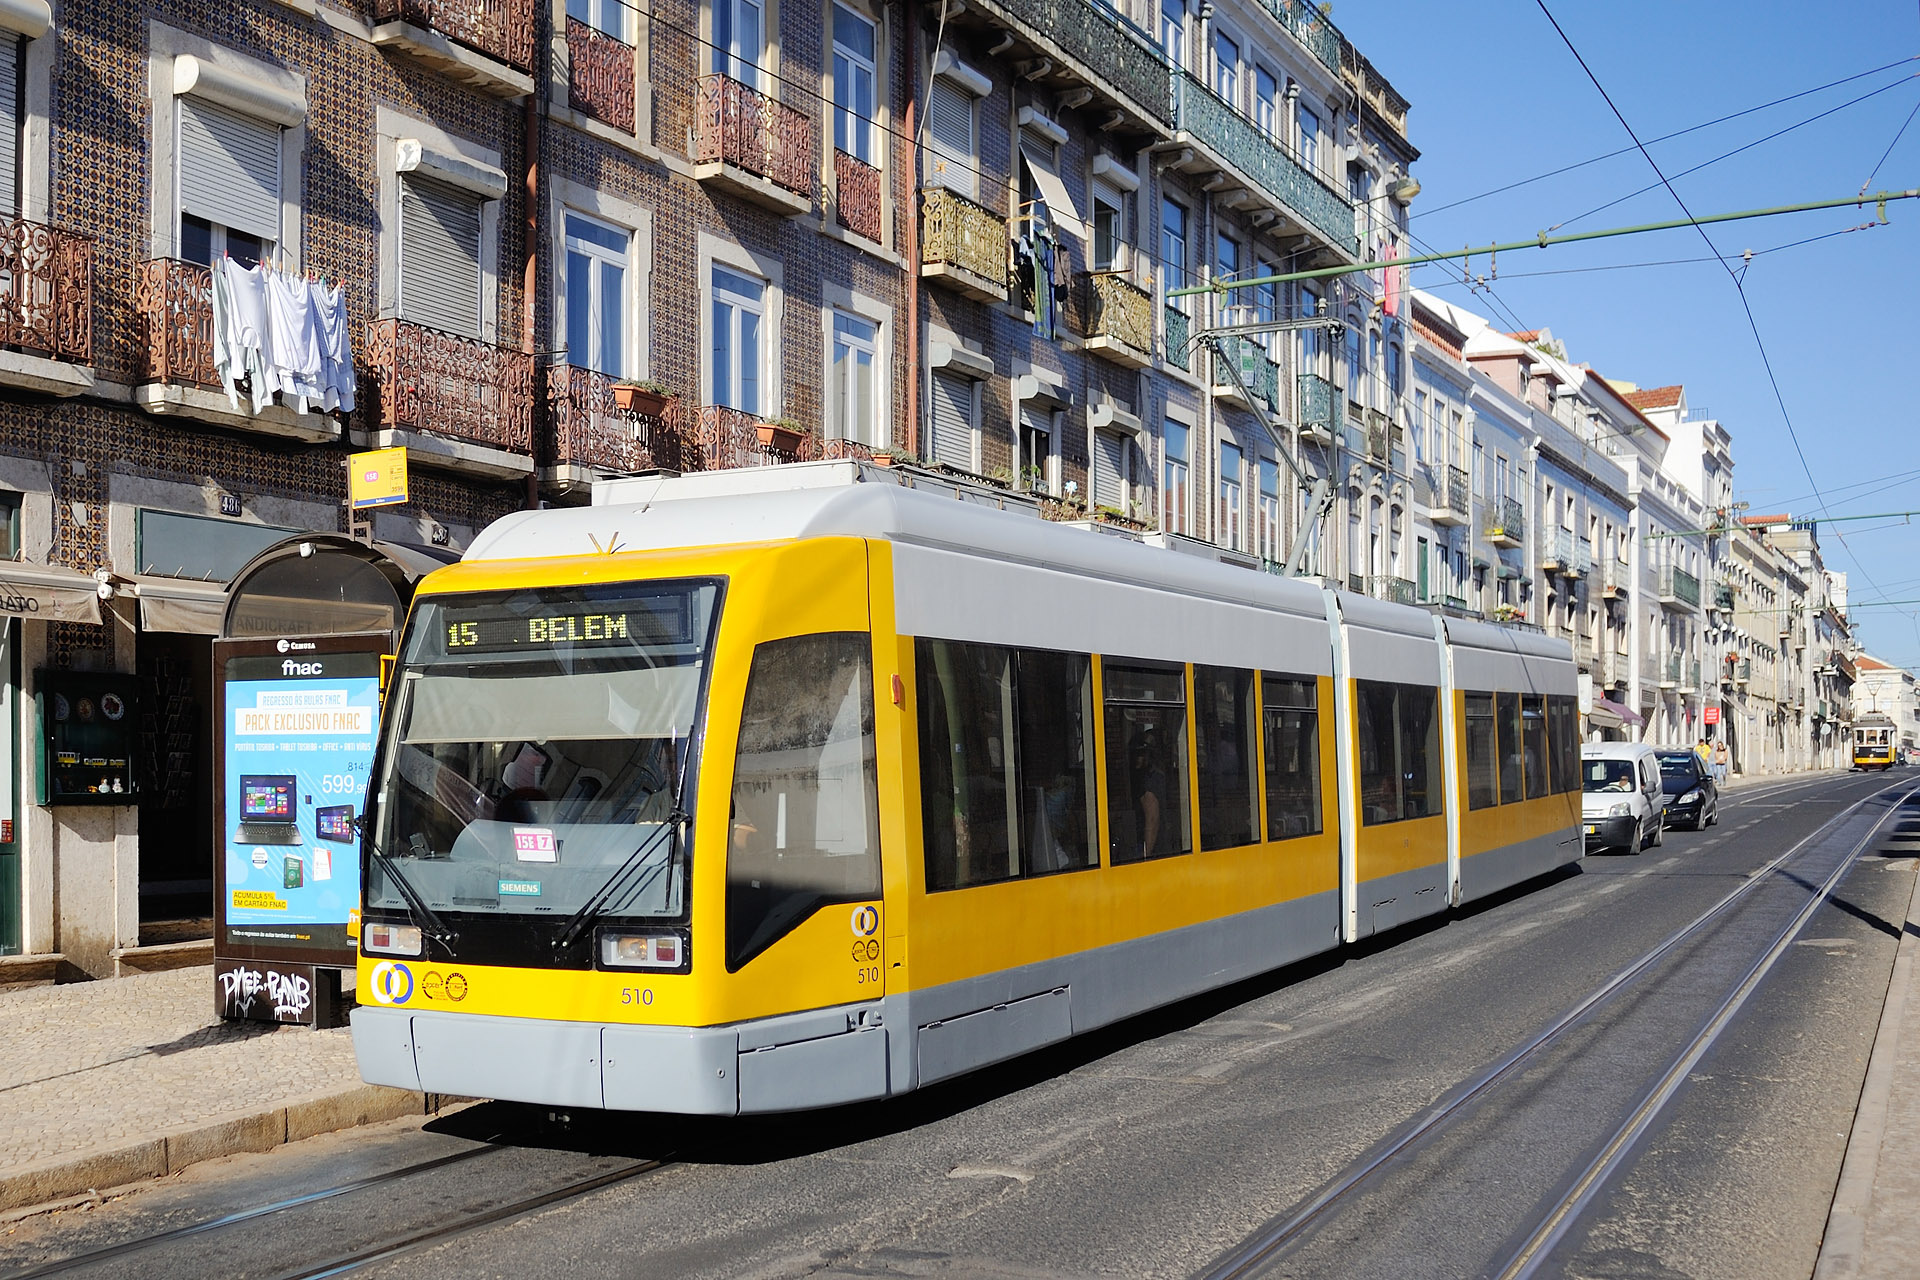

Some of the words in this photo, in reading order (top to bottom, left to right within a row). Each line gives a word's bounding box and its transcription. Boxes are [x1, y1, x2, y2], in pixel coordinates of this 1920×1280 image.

[222, 496, 240, 512] 486
[0, 595, 39, 612] ATO
[235, 615, 313, 634] ANDICRAFT
[449, 622, 478, 646] 15
[529, 614, 626, 642] BELEM
[281, 659, 323, 676] fnac
[262, 695, 293, 706] REGRESSO
[325, 694, 341, 705] FNAC
[245, 713, 271, 731] PACK
[274, 712, 329, 731] EXCLUSIVO
[333, 712, 360, 730] FNAC
[515, 835, 535, 849] 15E
[541, 837, 548, 848] 7
[233, 891, 263, 900] ACUMULA
[501, 883, 539, 893] SIEMENS
[269, 901, 286, 909] FNAC
[858, 966, 879, 984] 510
[621, 988, 654, 1006] 510
